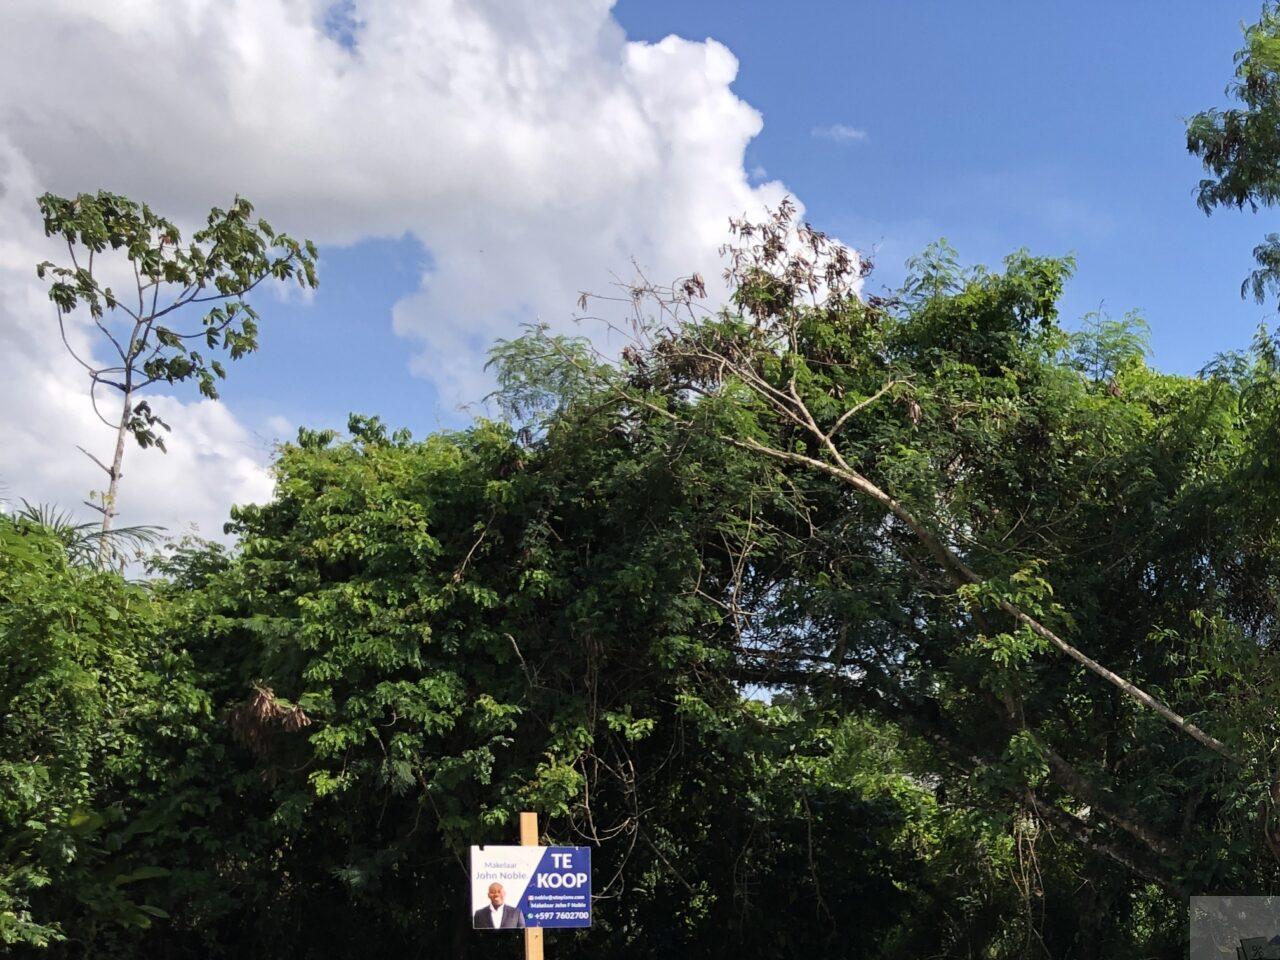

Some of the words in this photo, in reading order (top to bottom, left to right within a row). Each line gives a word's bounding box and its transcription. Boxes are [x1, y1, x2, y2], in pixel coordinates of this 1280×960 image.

[551, 853, 573, 869] TE
[476, 871, 498, 880] John
[500, 871, 527, 880] Noble
[537, 872, 588, 889] KOOP
[534, 911, 554, 920] +597
